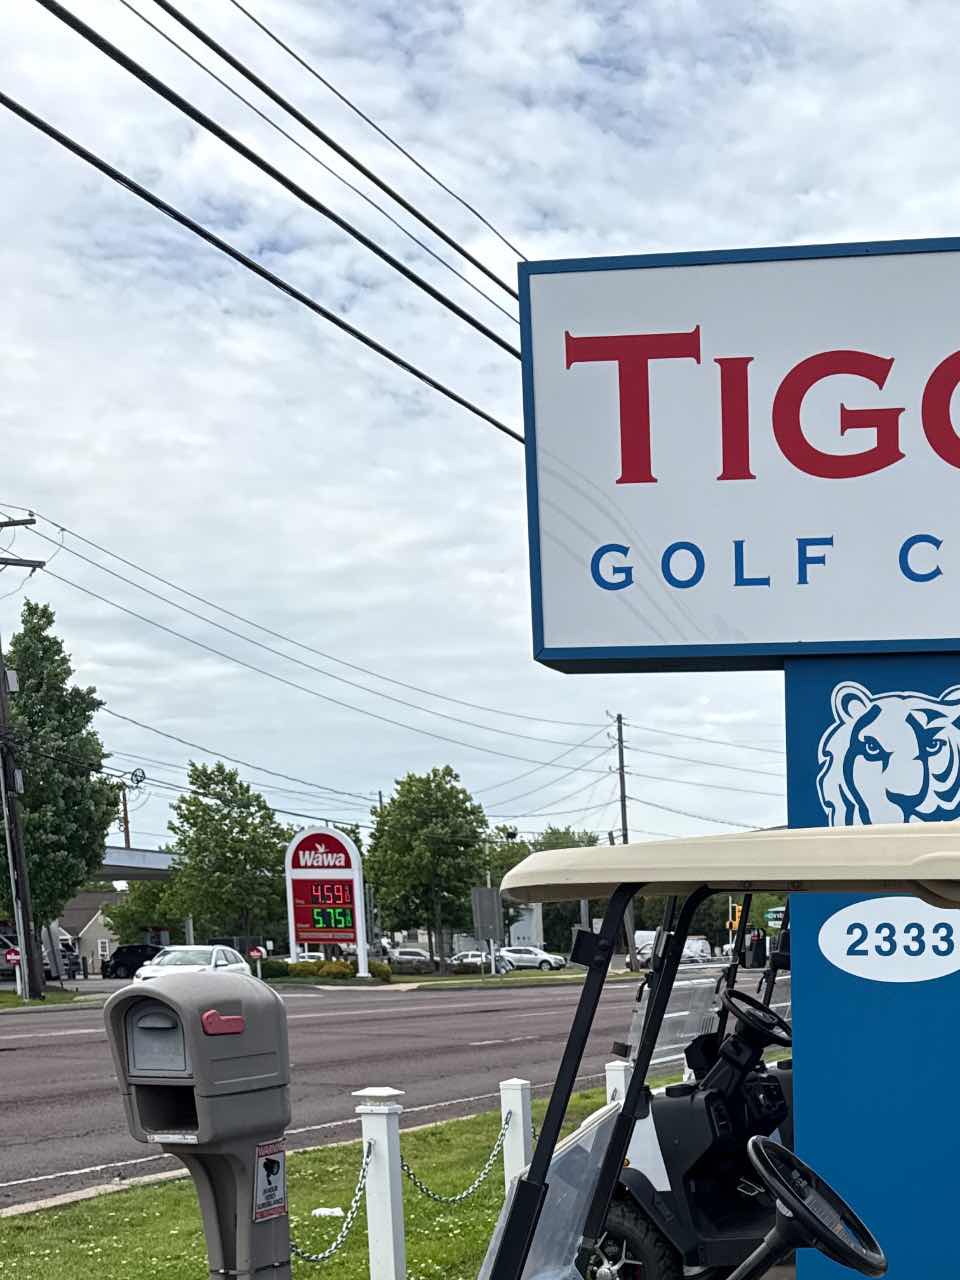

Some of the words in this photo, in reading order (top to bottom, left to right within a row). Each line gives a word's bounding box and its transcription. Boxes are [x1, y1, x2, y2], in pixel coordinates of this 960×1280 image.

[590, 533, 834, 591] GOLF
[298, 850, 346, 867] Wawa
[846, 922, 955, 957] 2333
